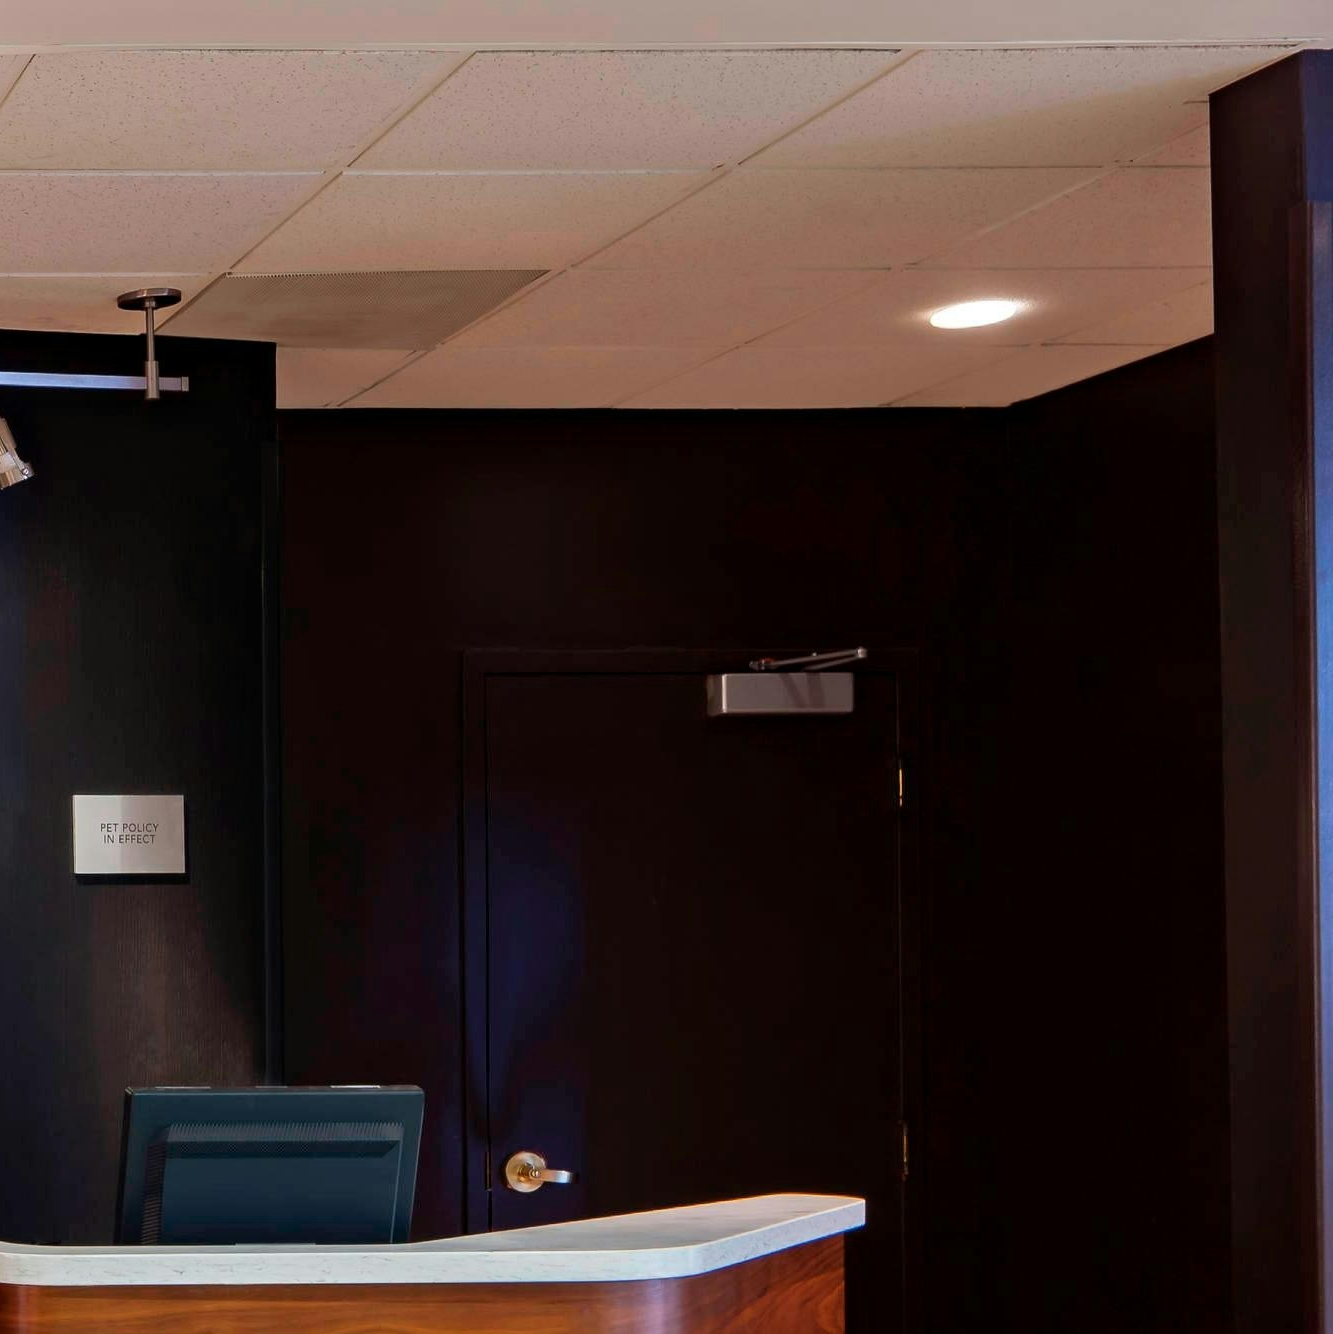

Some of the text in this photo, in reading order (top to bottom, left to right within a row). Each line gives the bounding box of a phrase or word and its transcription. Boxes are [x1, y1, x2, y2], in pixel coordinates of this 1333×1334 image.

[101, 823, 159, 832] PET POLICY
[103, 835, 157, 844] IN EFFECT
